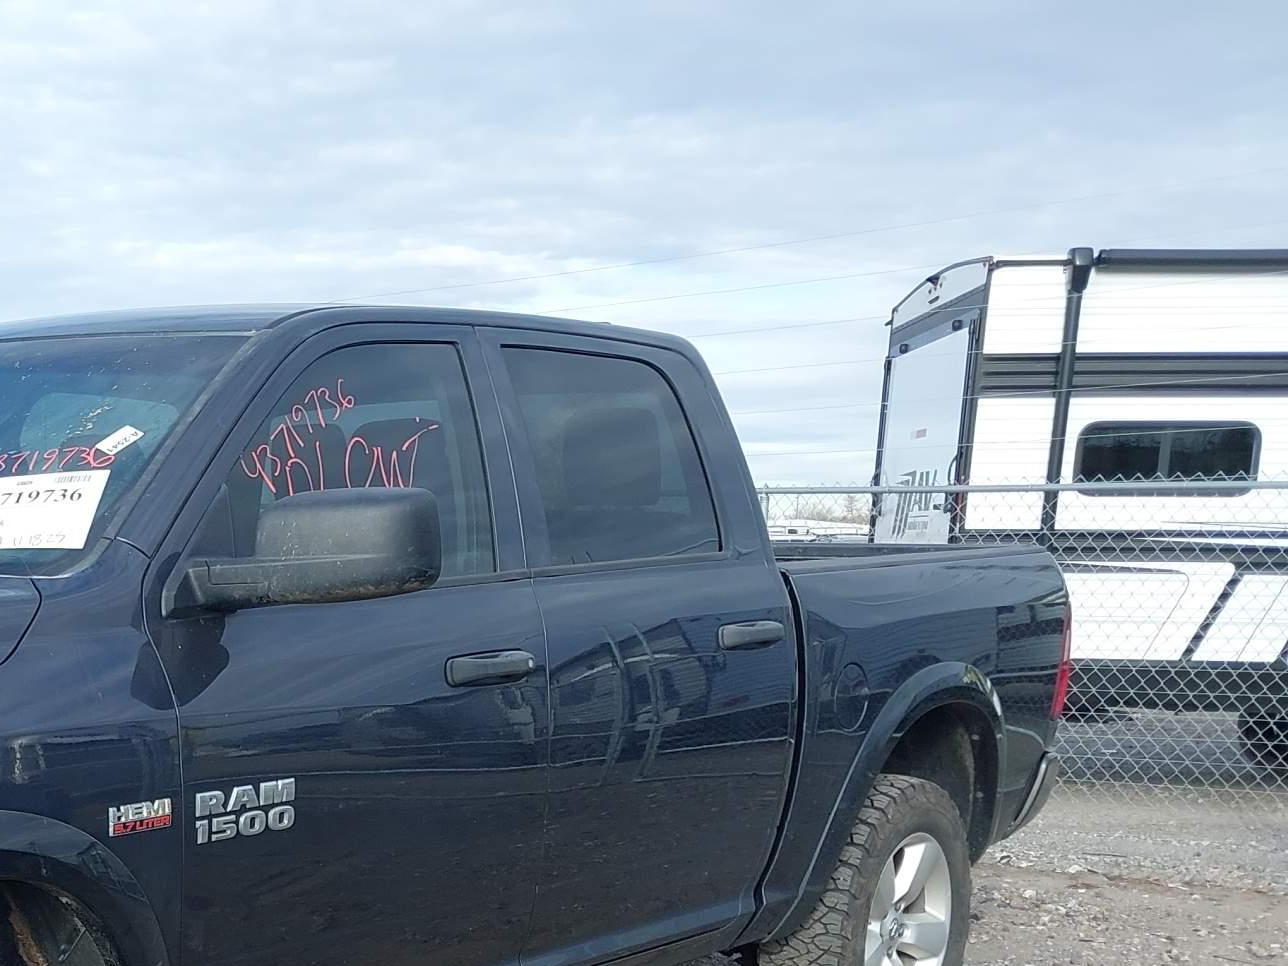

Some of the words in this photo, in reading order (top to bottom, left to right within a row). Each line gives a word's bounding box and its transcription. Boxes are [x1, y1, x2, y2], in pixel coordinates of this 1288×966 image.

[240, 379, 355, 494] 43719736
[108, 797, 173, 824] HEMI
[194, 777, 297, 818] RAM
[136, 815, 170, 831] LITER
[195, 805, 297, 845] 1500
